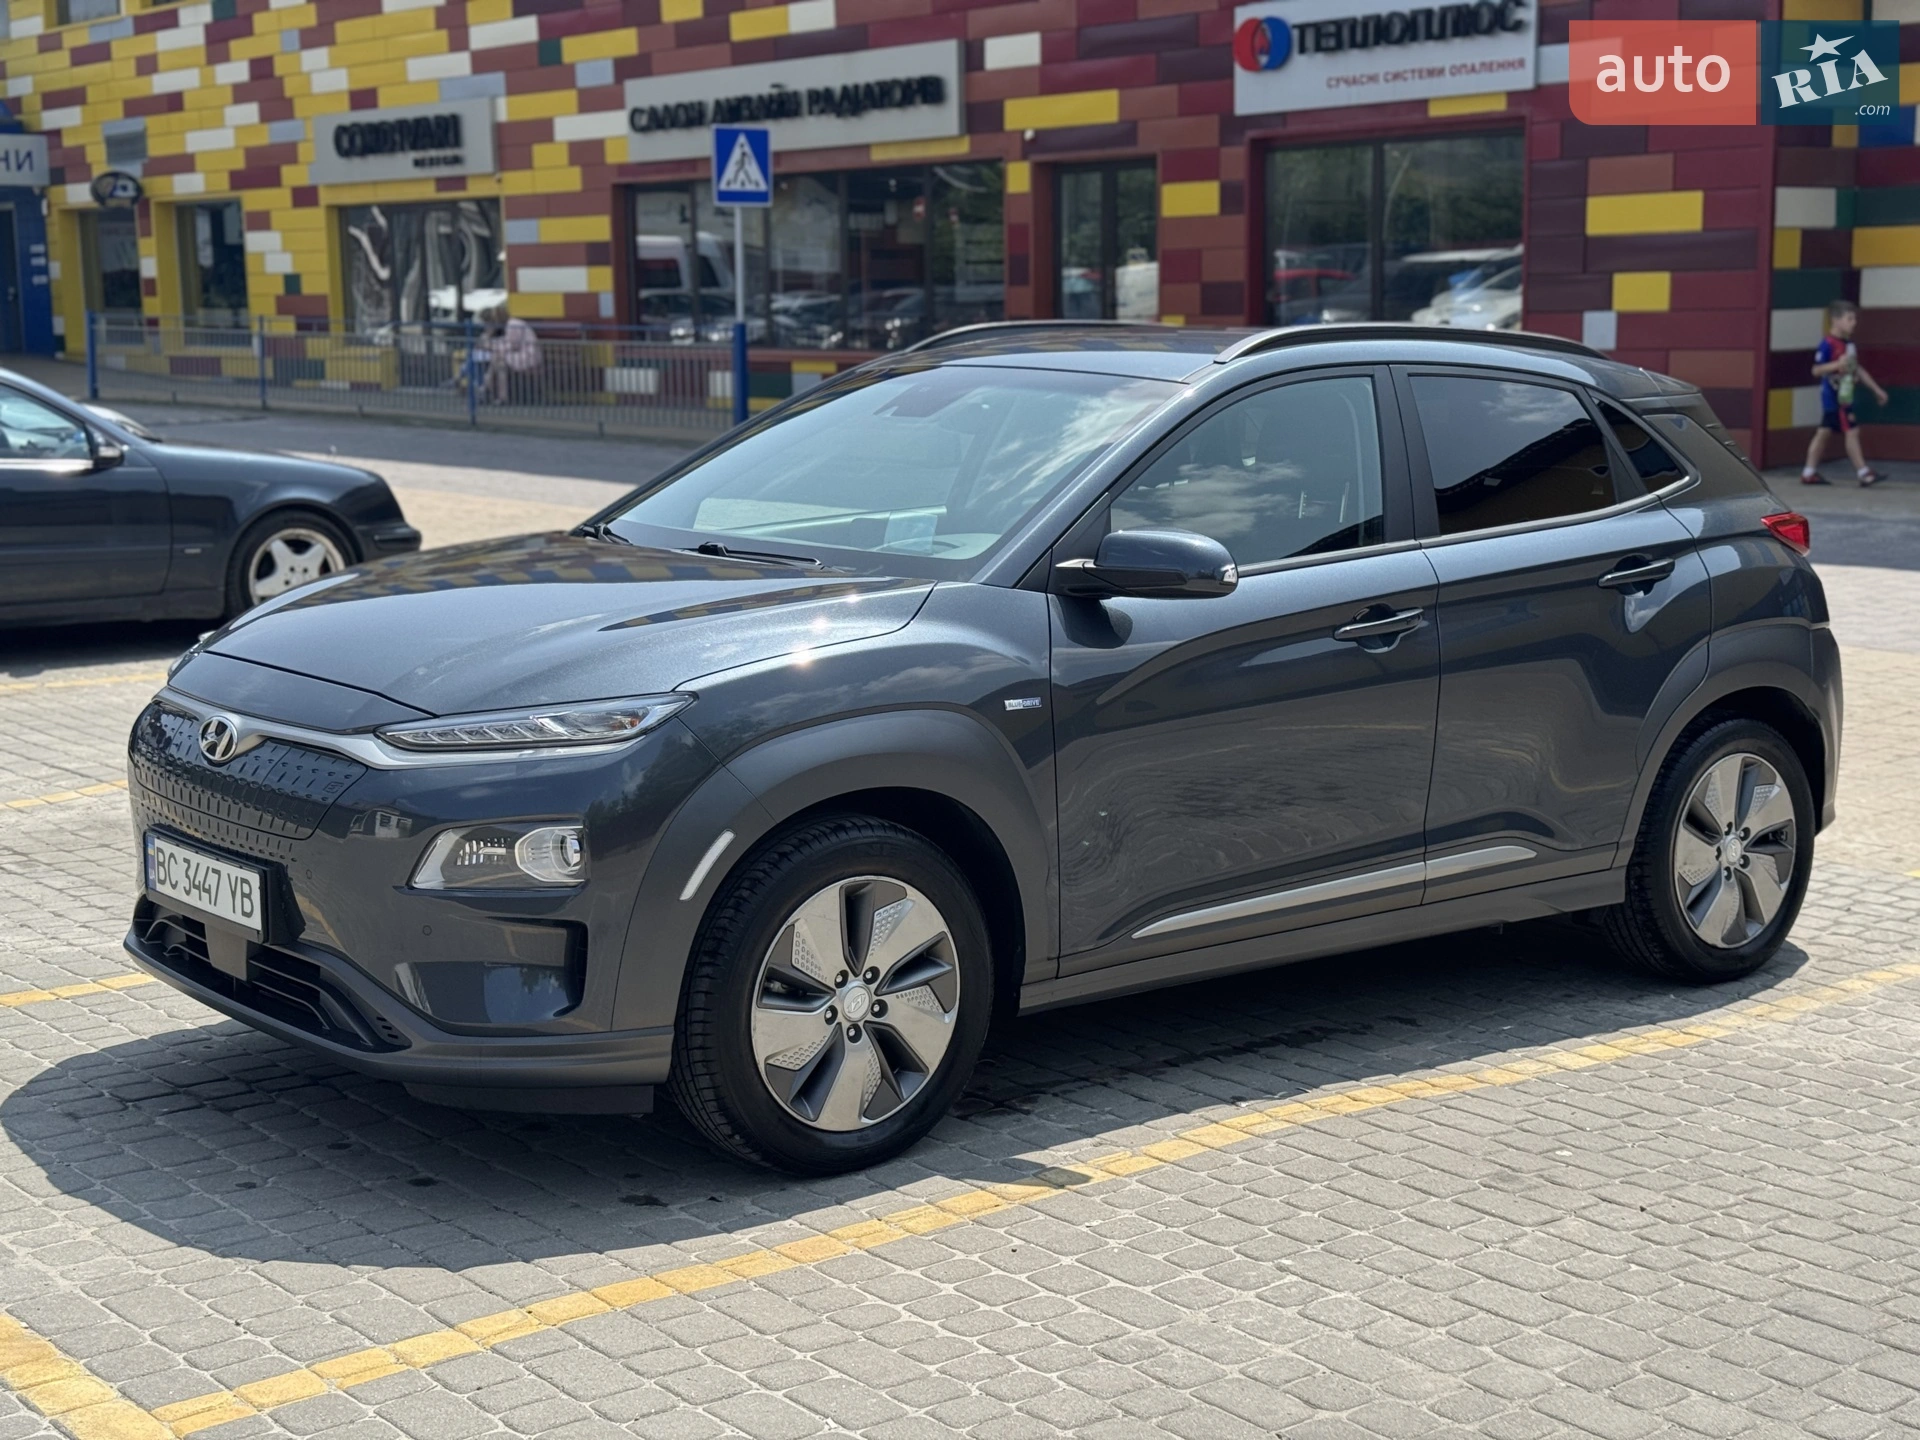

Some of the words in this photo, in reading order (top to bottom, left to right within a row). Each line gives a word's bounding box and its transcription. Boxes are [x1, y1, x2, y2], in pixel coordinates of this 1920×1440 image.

[1293, 0, 1526, 54] ТЕПЛОПЛЮС
[1327, 73, 1379, 89] СУЧАСНІ
[1384, 66, 1446, 84] СИСТЕМИ
[1450, 58, 1526, 77] ОПАЛЕННЯ
[630, 101, 706, 132] САЛОН
[156, 847, 178, 890] BC
[183, 857, 221, 907] 3447
[227, 873, 254, 918] YB
